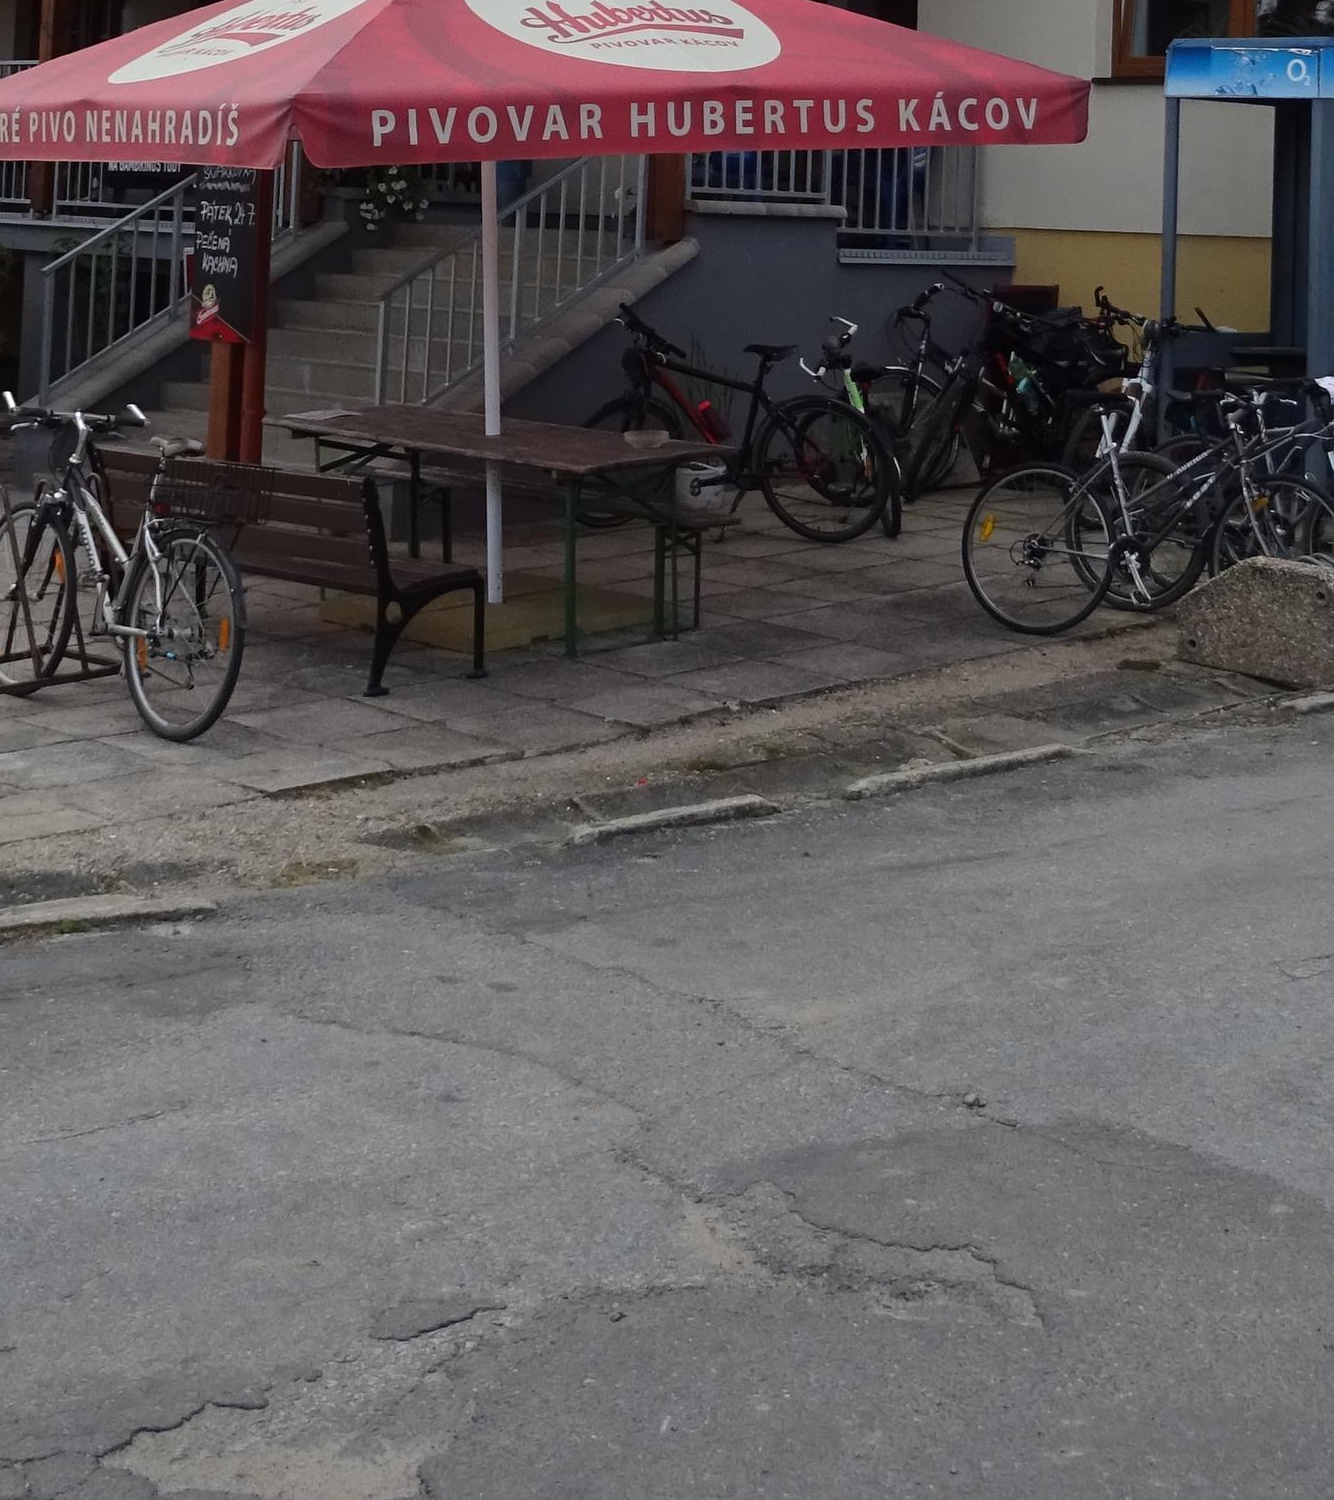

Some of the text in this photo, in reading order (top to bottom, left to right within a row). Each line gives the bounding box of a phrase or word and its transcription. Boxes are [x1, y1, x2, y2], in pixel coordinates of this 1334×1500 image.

[520, 0, 734, 44] Hubertus
[29, 109, 76, 143] PIVO
[85, 103, 241, 146] NENAHRADÍŠ
[371, 92, 1039, 148] PIVOVAR HUBERTUS KÁCOV
[200, 200, 233, 226] PÁTEK
[202, 253, 238, 279] KACHNA
